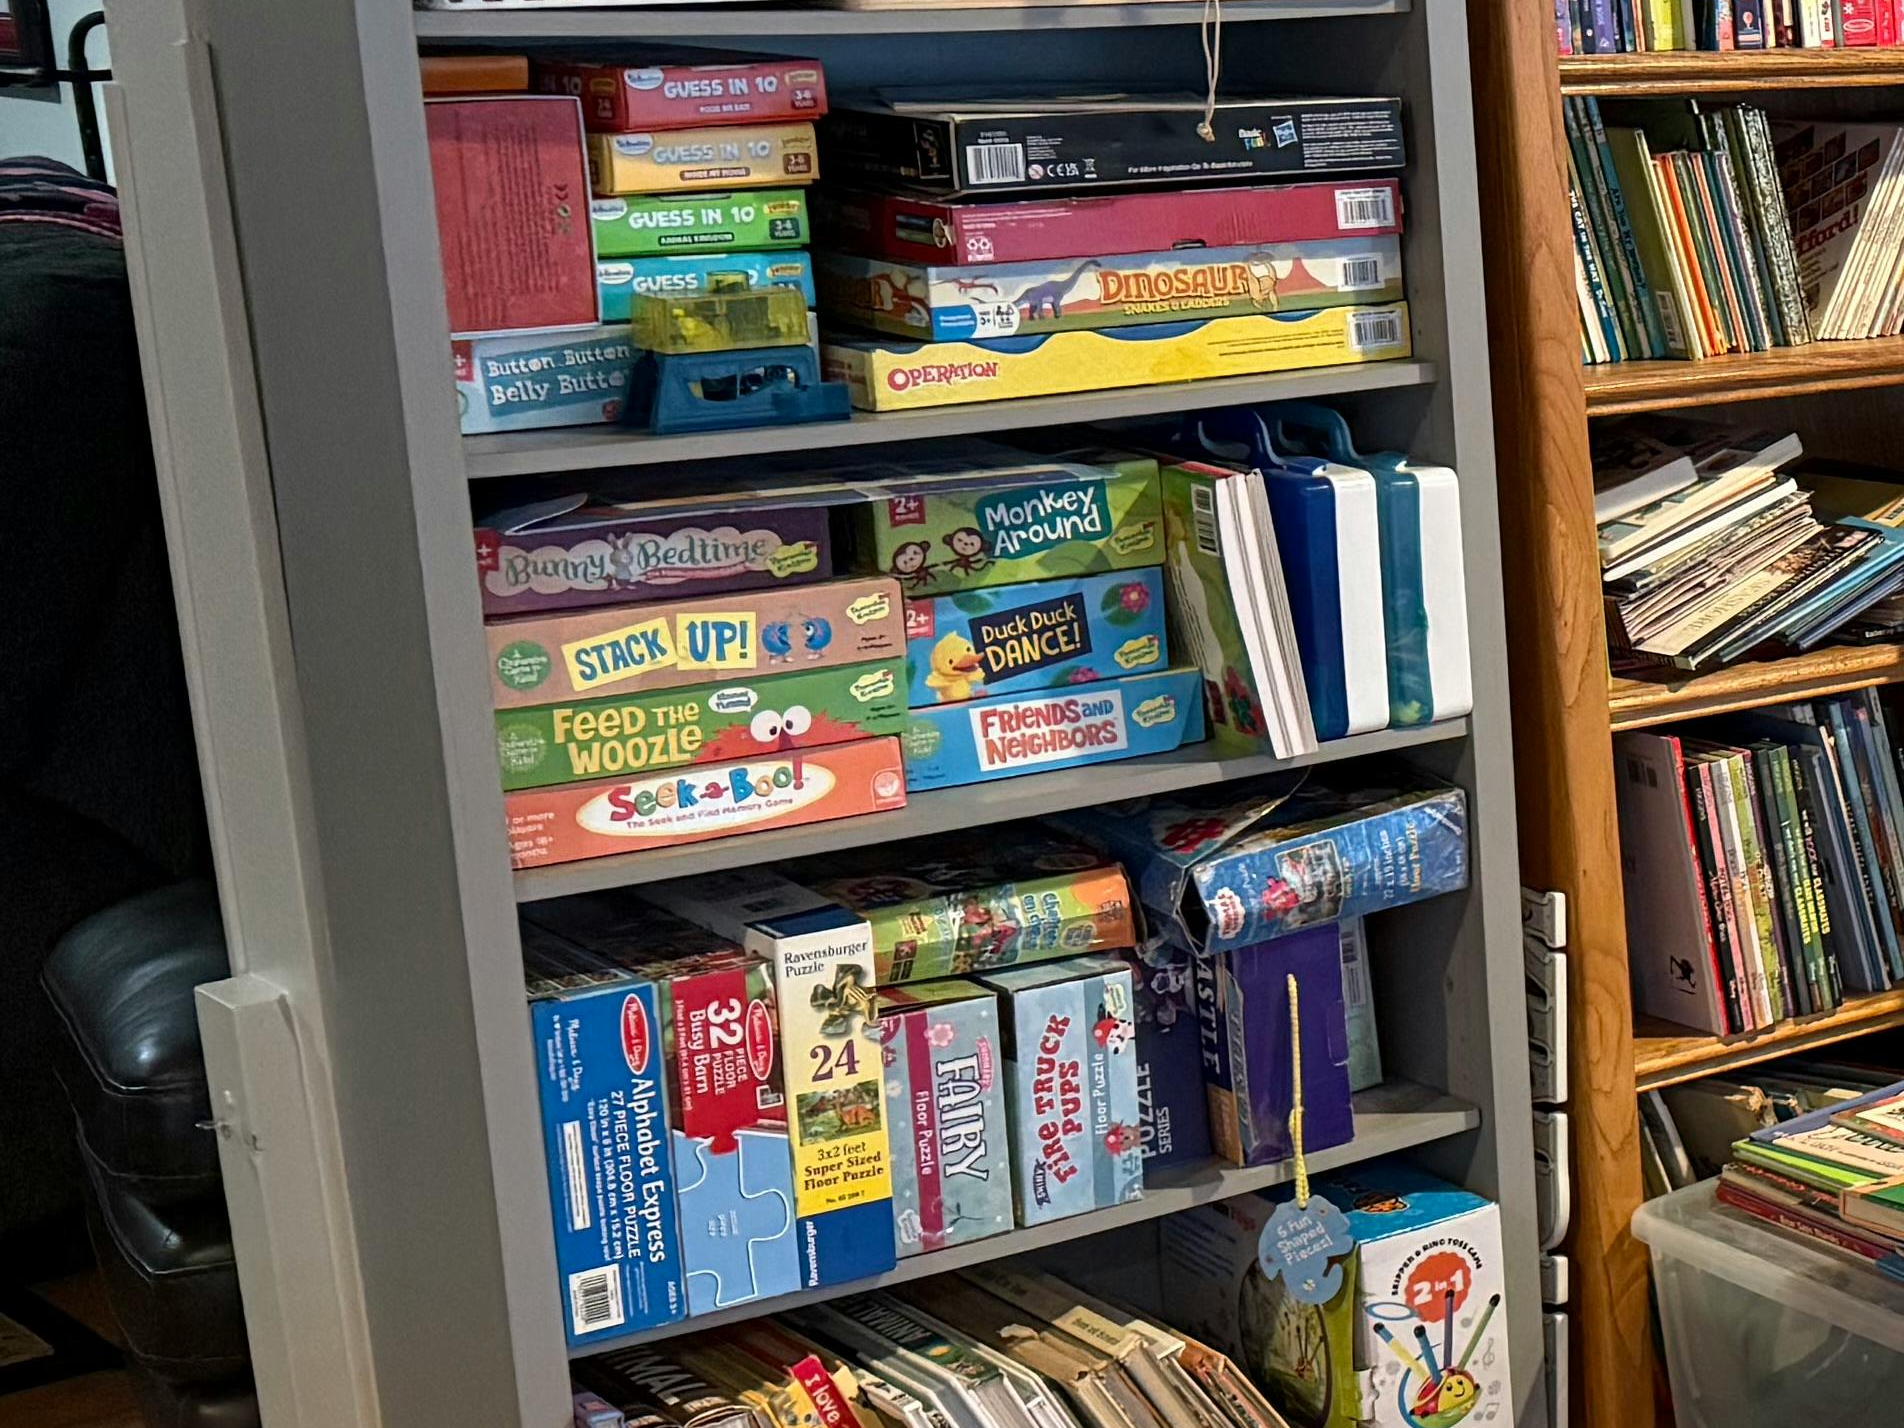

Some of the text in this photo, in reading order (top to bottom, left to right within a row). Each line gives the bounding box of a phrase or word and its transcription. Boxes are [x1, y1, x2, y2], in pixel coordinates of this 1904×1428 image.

[664, 75, 778, 100] GUESS IN 10
[653, 140, 771, 164] GUESS IN 10
[628, 206, 755, 229] GUESS IN 10
[632, 273, 698, 293] GUESS
[1099, 262, 1250, 304] DINOSAUR
[487, 345, 631, 378] Button Button
[887, 362, 999, 393] OPERATION
[490, 380, 550, 406] Belly
[985, 486, 1096, 532] Monkey
[993, 505, 1102, 557] Around
[505, 535, 766, 587] Bunny Bedtime
[981, 601, 1077, 644] Duck Duck
[578, 628, 670, 682] STACK
[686, 620, 749, 662] UP!
[984, 622, 1082, 673] DANCE!
[627, 818, 646, 831] The
[648, 814, 674, 829] Seek
[676, 811, 696, 825] and
[698, 808, 721, 823] Find
[766, 796, 795, 810] Game
[783, 939, 869, 966] Ravensburger
[785, 959, 826, 979] Puzzle
[708, 998, 742, 1050] 32
[689, 1007, 710, 1095] Busy Barn
[724, 1049, 738, 1091] FLOOR
[736, 1048, 749, 1083] PIECE
[809, 1039, 861, 1084] 24
[1032, 1013, 1072, 1117] TRUCK
[710, 1051, 726, 1097] PUZZLE
[1091, 1052, 1111, 1135] Floor Puzzle
[935, 1054, 990, 1182] FAIRY
[1058, 1058, 1084, 1138] PUPS
[817, 1140, 867, 1162] 3x2 feet
[914, 1089, 934, 1177] Floor Puzzle
[1157, 1105, 1173, 1155] SERIES
[611, 1090, 642, 1260] 27 PIECE FLOOR PUZZLE
[631, 1078, 667, 1264] Alphabet Express
[804, 1150, 882, 1180] Super Sized
[804, 1165, 886, 1192] Floor Puzzle
[807, 1220, 821, 1288] Ravensburger
[1277, 1224, 1327, 1254] Shaped
[1413, 1280, 1434, 1306] 2
[804, 1374, 818, 1387] I
[811, 1383, 841, 1423] love
